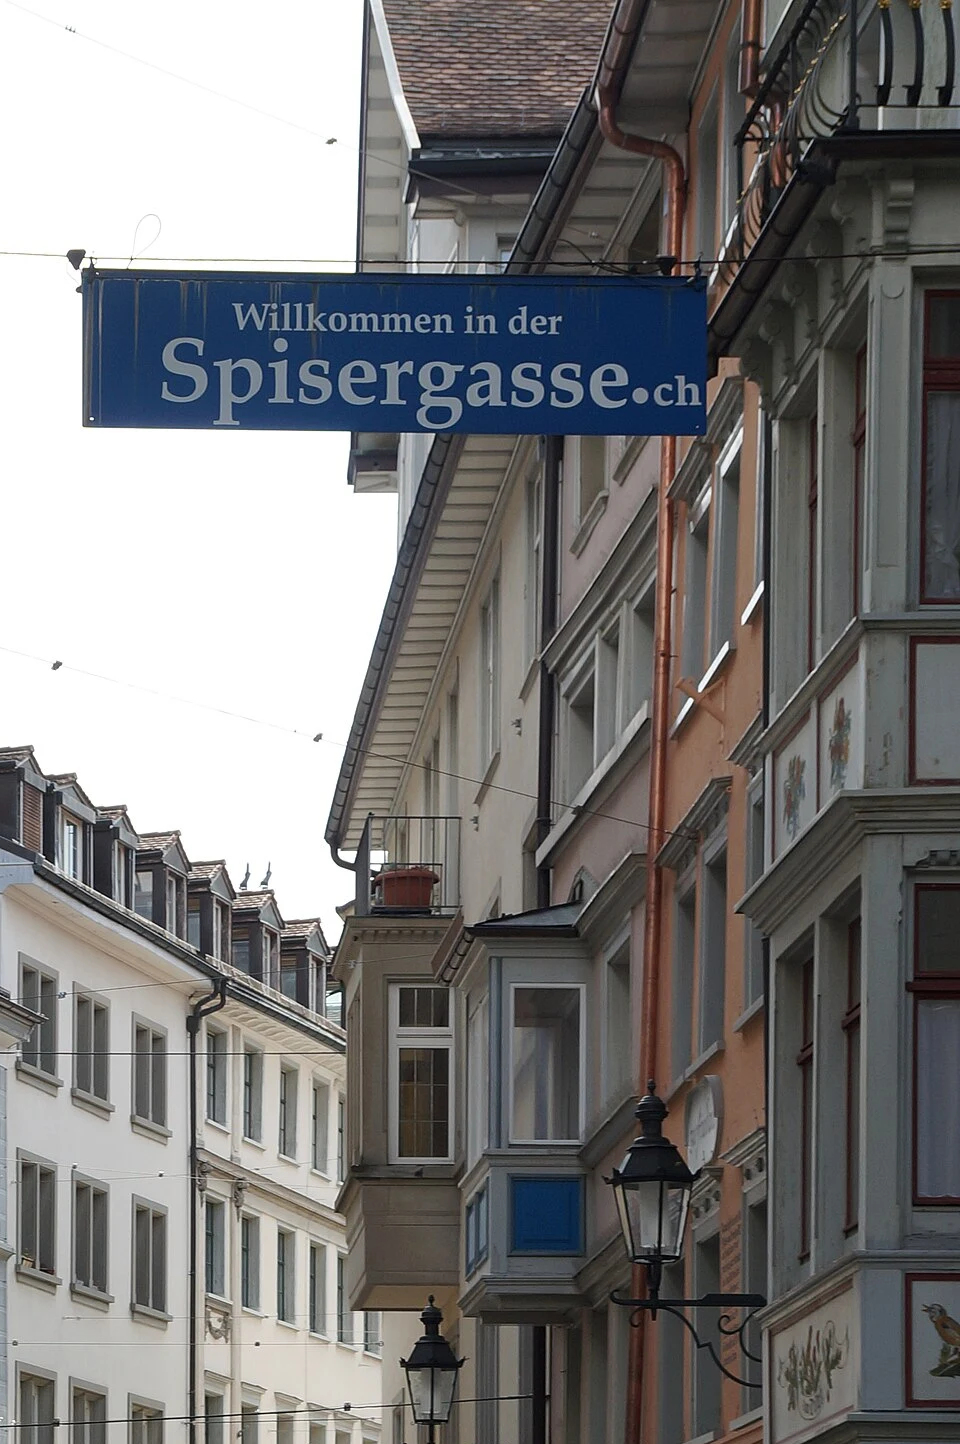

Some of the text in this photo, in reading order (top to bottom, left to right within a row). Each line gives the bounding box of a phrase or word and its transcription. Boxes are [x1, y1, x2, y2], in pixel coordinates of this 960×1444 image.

[232, 302, 563, 336] Willkommen in der
[161, 336, 703, 430] Spisergasse.ch
